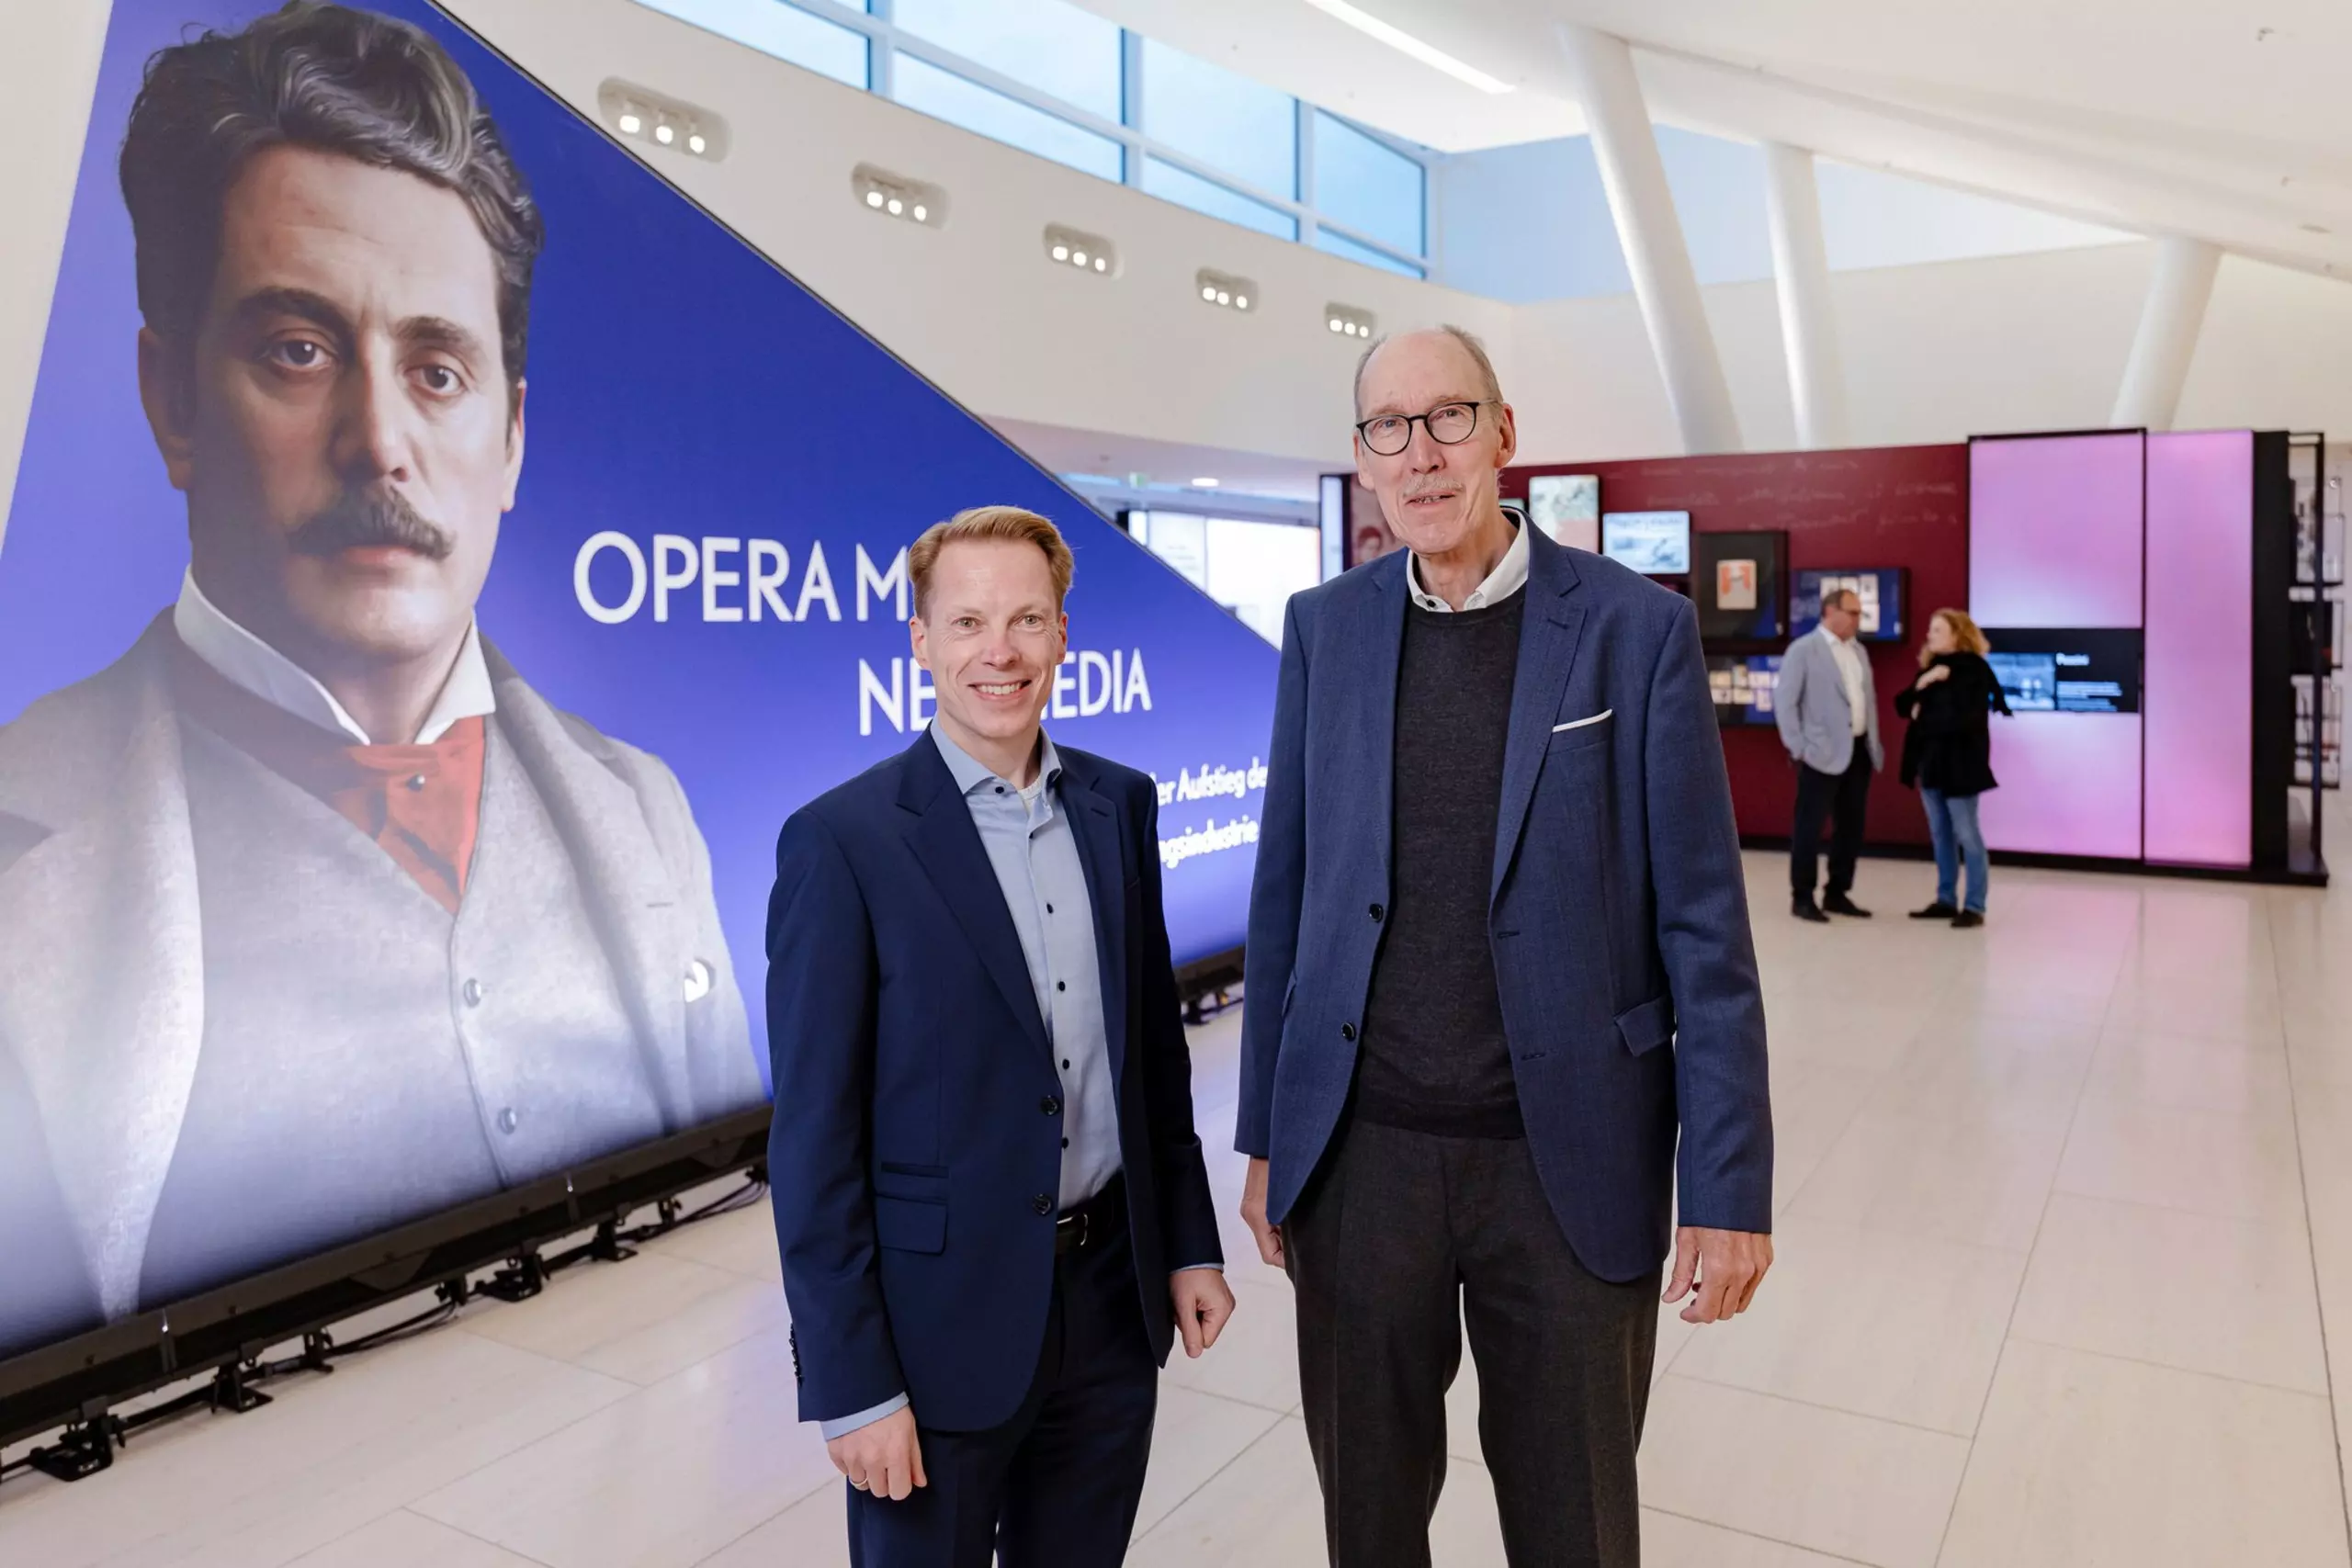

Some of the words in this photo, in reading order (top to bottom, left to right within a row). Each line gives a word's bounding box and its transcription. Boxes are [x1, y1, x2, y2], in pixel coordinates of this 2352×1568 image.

[573, 530, 842, 625] OPERA
[855, 542, 909, 622] M
[858, 657, 937, 736] NE
[1040, 647, 1153, 720] EDIA
[1149, 771, 1177, 807] er
[1176, 763, 1246, 802] Aufstieg
[1247, 756, 1268, 789] de
[1159, 814, 1259, 869] ngsindustrie
